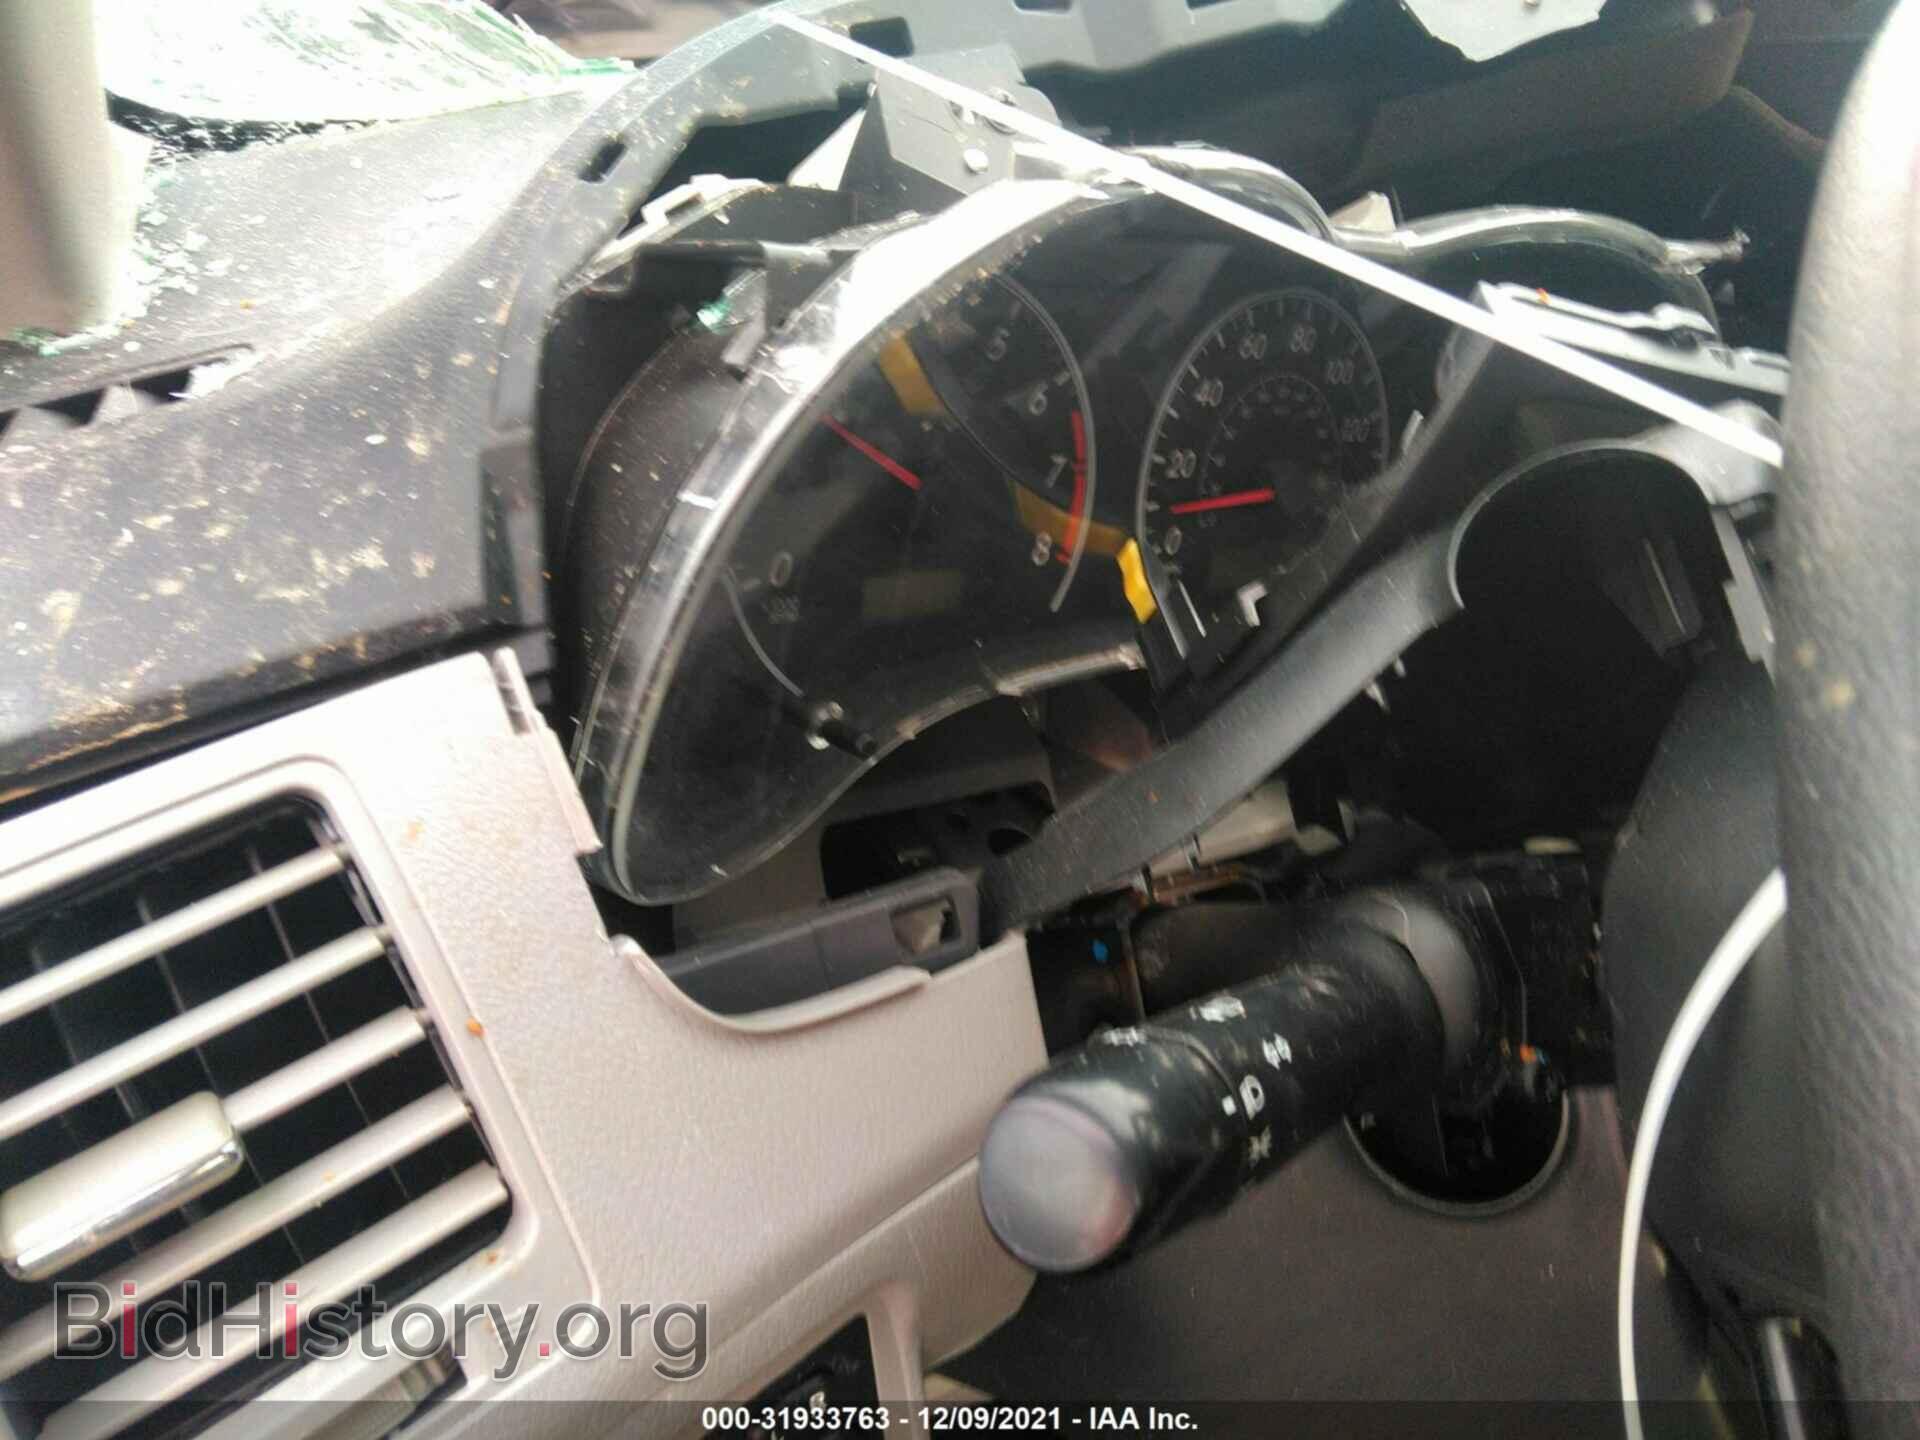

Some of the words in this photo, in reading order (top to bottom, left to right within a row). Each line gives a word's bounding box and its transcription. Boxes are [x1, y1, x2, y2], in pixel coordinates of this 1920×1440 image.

[985, 328, 1011, 361] 5
[1289, 326, 1318, 353] 80
[1324, 359, 1355, 385] 100
[1027, 383, 1049, 415] 6
[1194, 379, 1225, 407] 40
[1045, 454, 1069, 487] 7
[1165, 449, 1196, 479] 20
[1031, 533, 1053, 566] 8
[1163, 525, 1182, 556] 0
[768, 551, 793, 587] 0
